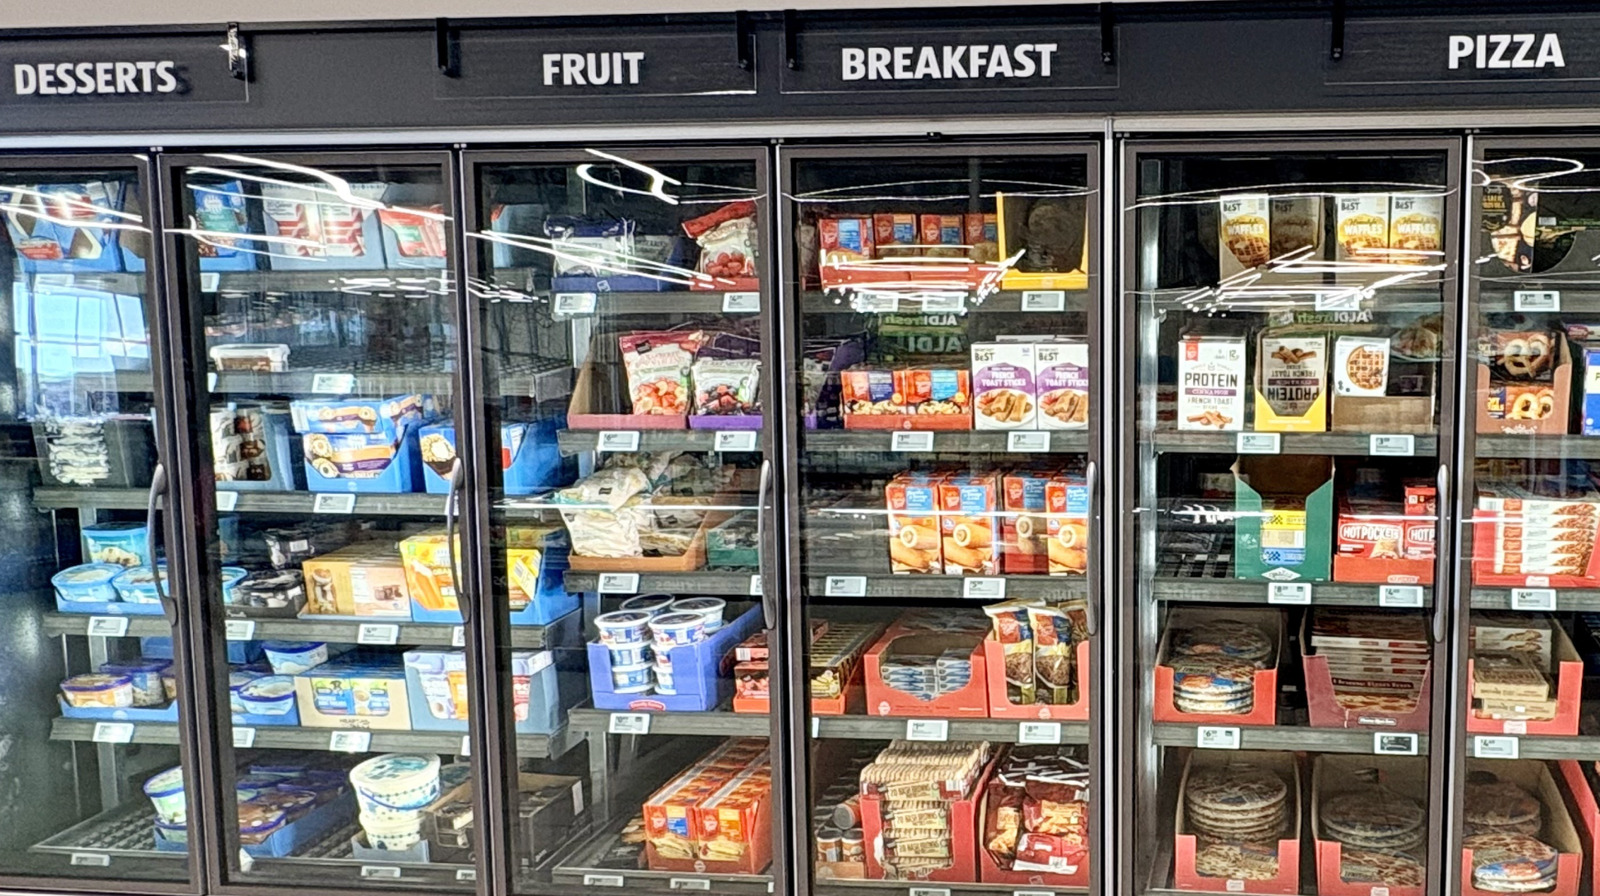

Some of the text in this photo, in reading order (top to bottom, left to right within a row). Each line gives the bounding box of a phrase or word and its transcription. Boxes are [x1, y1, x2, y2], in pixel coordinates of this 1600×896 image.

[1448, 33, 1565, 69] PIZZA
[841, 43, 1058, 81] BREAKFAST
[542, 52, 645, 86] FRUIT
[14, 61, 178, 95] DESSERTS
[1227, 223, 1265, 235] WAFFLES
[1343, 223, 1383, 235] WAFFLES
[1396, 222, 1437, 234] WAFFLES
[974, 352, 996, 361] BEST
[1038, 352, 1060, 361] BEST
[981, 379, 1027, 387] TOAST STICKS
[1045, 379, 1066, 387] TOAST
[1184, 372, 1238, 387] PROTEIN
[1267, 387, 1320, 401] PROTEIN
[1213, 397, 1233, 405] TOAST
